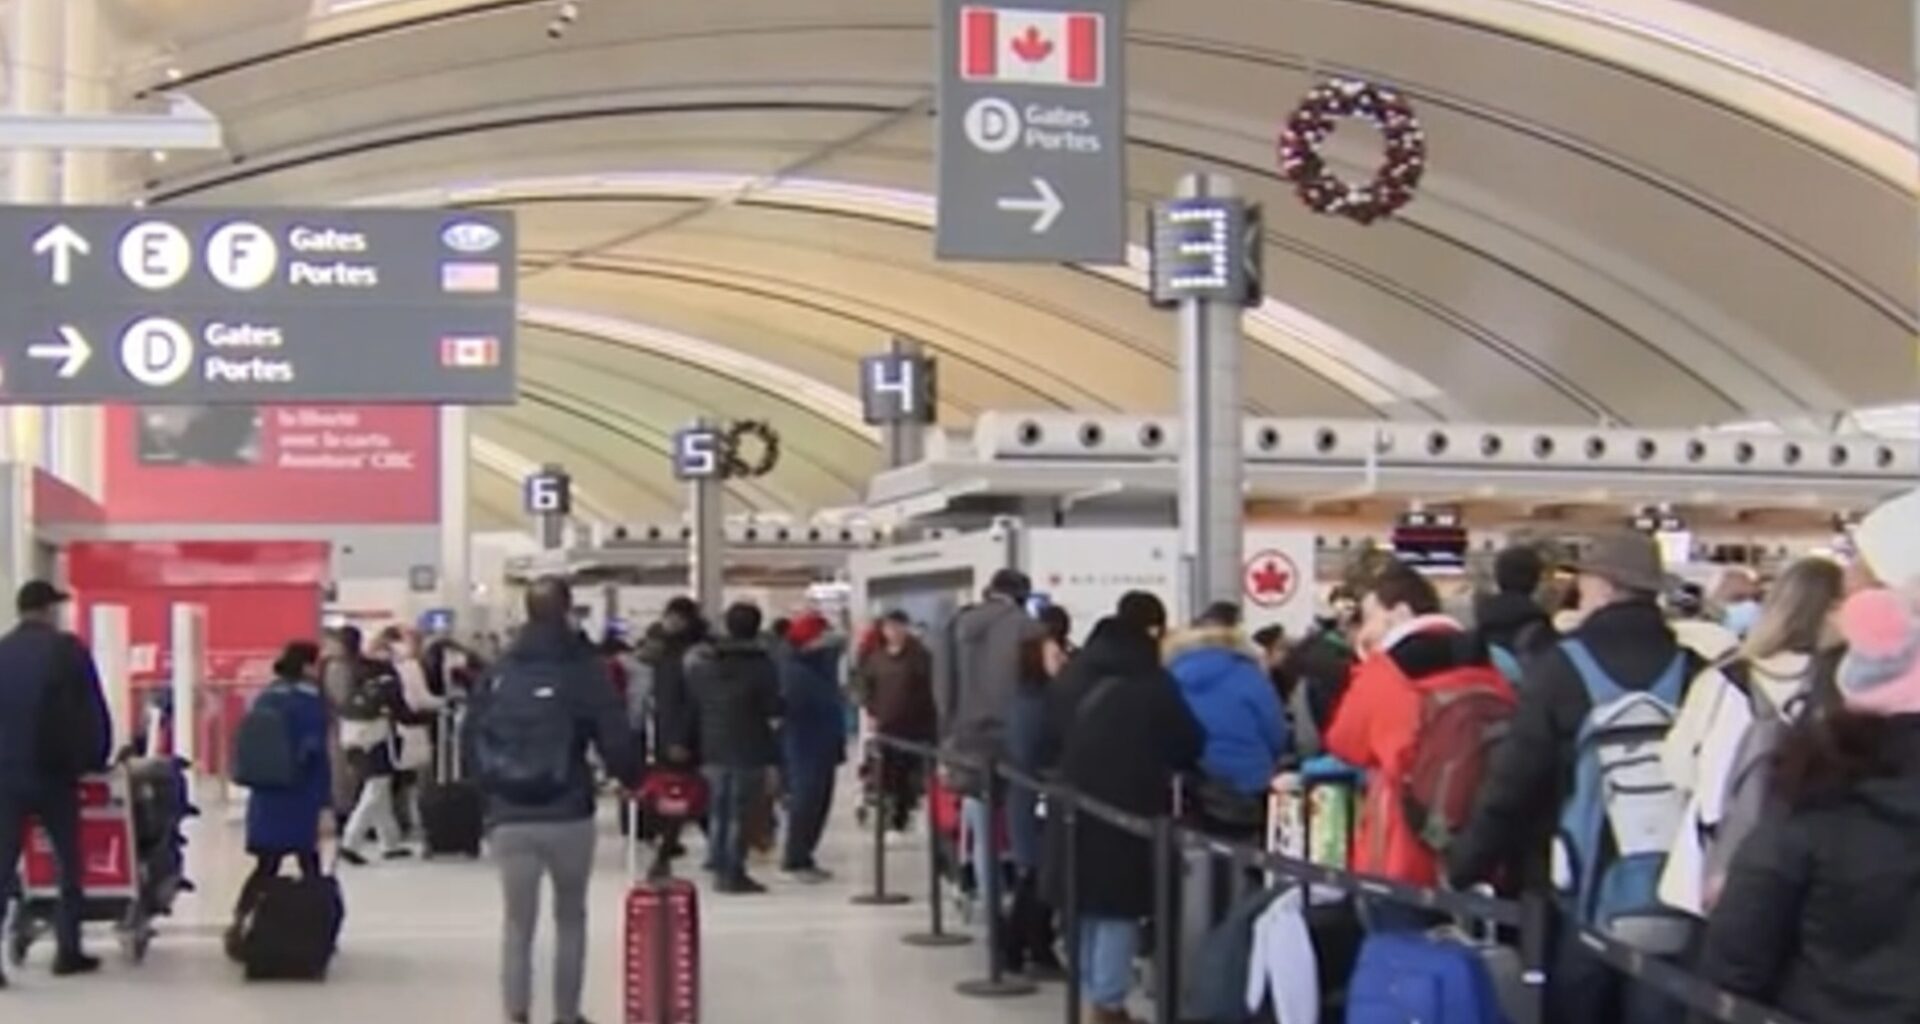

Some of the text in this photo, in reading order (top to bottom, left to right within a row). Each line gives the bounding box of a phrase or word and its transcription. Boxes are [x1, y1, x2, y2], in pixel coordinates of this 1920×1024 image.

[980, 105, 1090, 142] D Gates
[1026, 128, 1101, 151] Portes
[142, 228, 367, 275] E F Gates
[1169, 208, 1227, 288] 3
[289, 262, 378, 285] Portes
[143, 323, 282, 373] D Gates
[205, 357, 294, 381] Portes
[874, 360, 912, 412] 4
[683, 434, 714, 473] 5
[532, 478, 558, 510] 6
